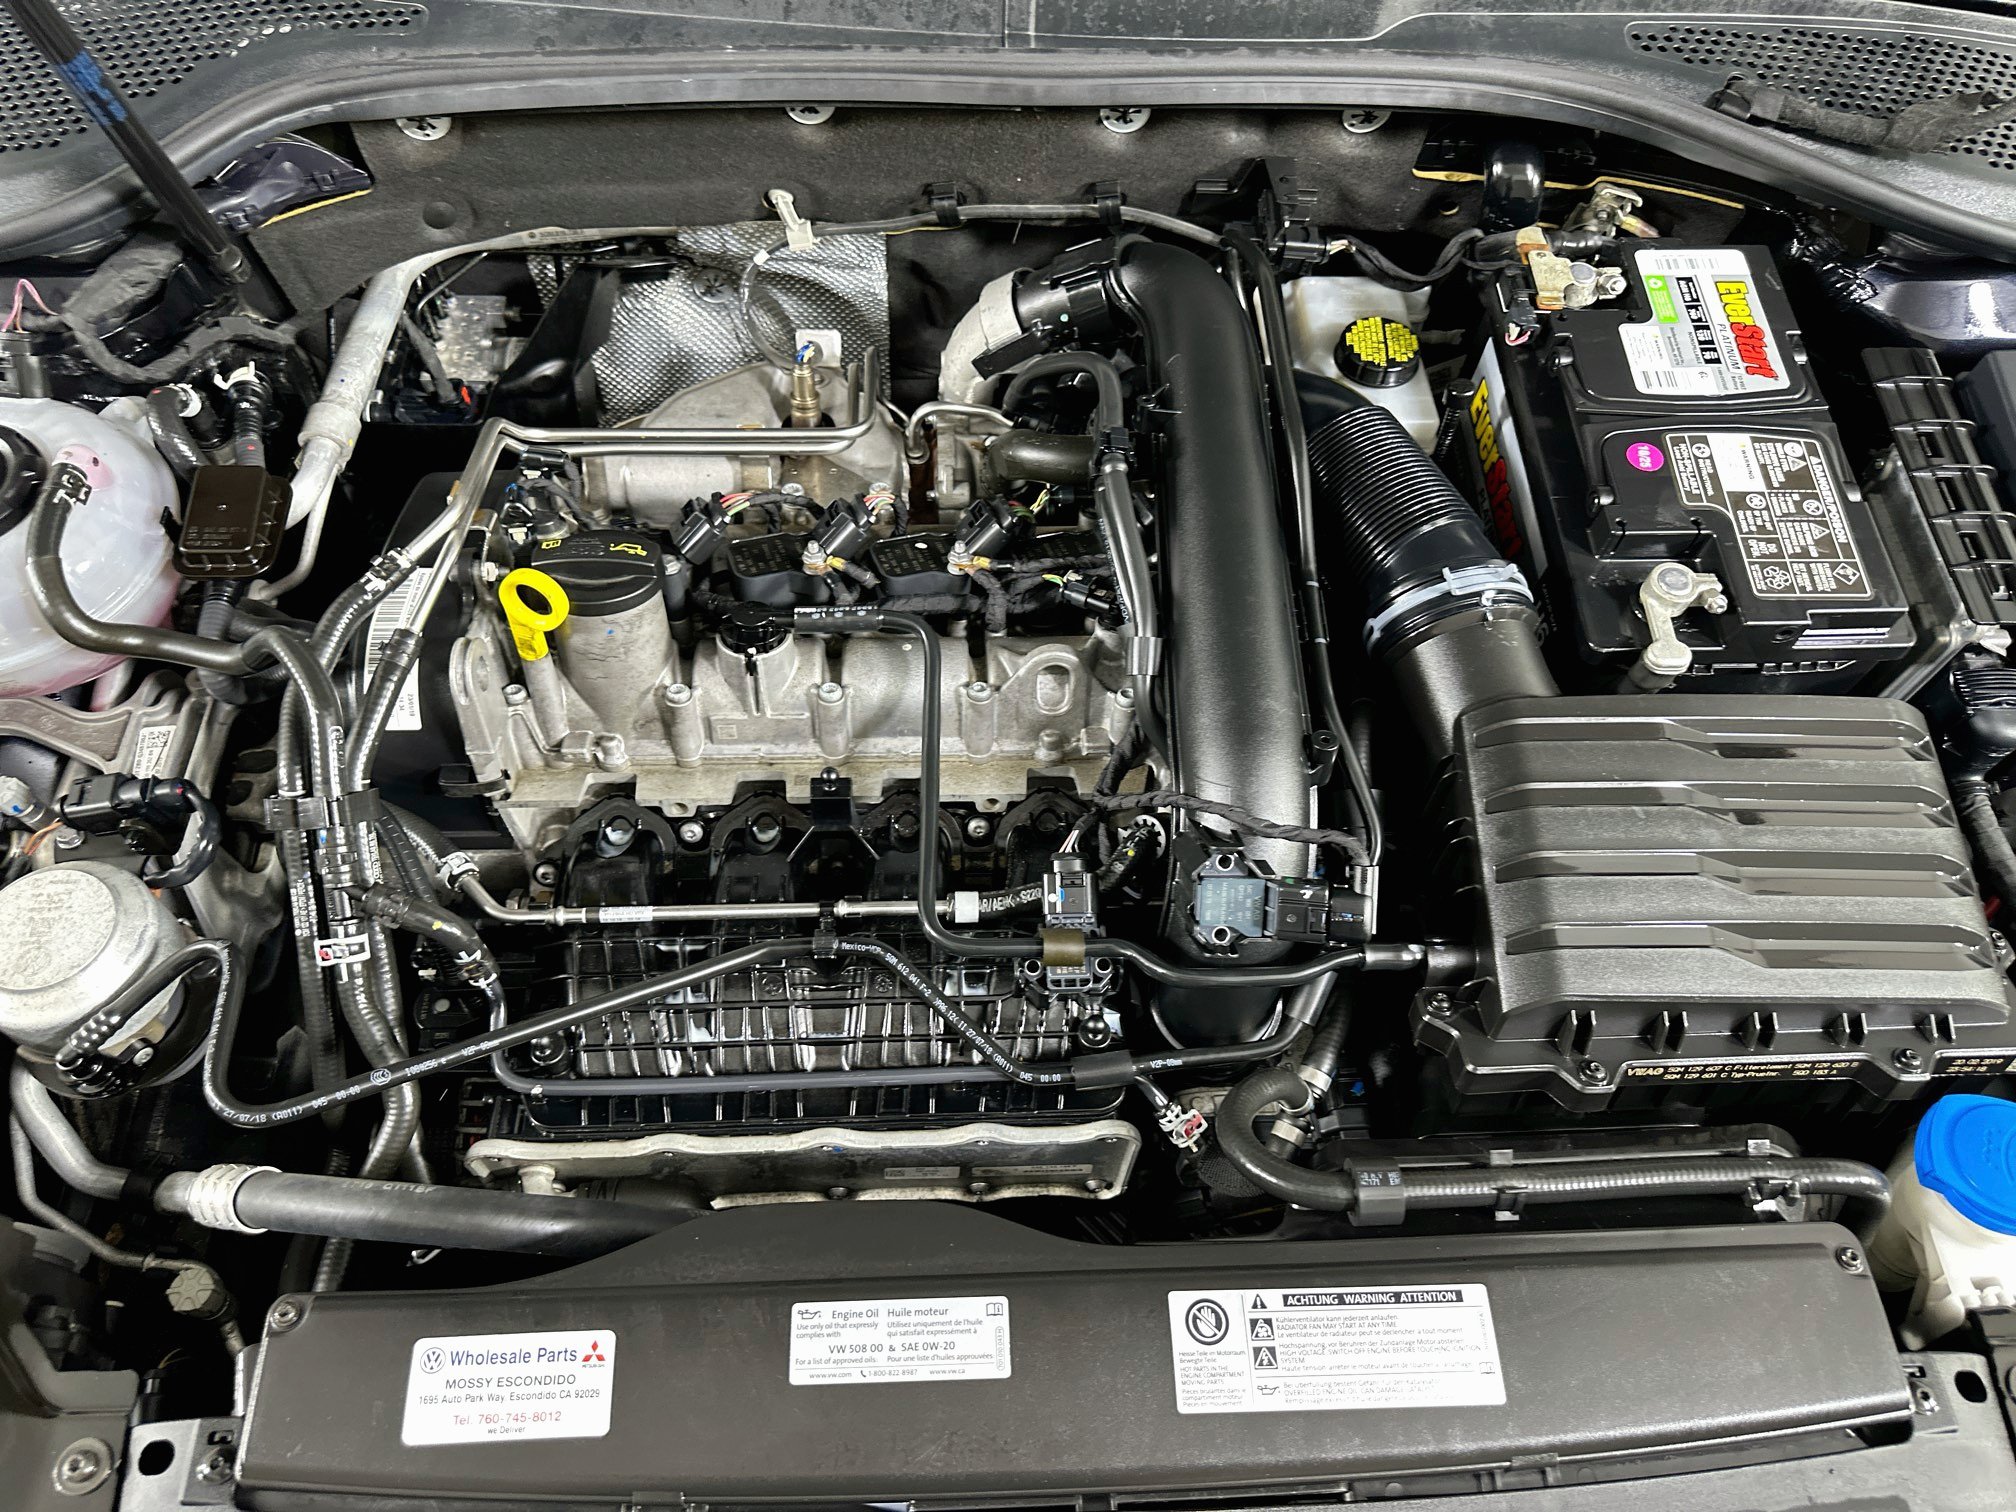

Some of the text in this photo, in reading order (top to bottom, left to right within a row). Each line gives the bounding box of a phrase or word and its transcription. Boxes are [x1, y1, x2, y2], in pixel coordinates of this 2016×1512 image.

[1715, 280, 1778, 380] EverStart
[1717, 323, 1741, 370] PLATINUM
[1741, 450, 1755, 480] WARNING
[1627, 1068, 1664, 1076] VWAG
[1733, 1063, 1792, 1071] Filterelement
[223, 1108, 267, 1123] 27/07/18
[1286, 1291, 1457, 1306] ACHTUNG WARNING ATTENTION
[831, 1309, 879, 1321] Engine Oil
[887, 1307, 949, 1318] Huile moteur
[810, 1322, 824, 1331] only
[825, 1321, 834, 1329] oil
[834, 1321, 847, 1329] that
[848, 1320, 878, 1330] expressly
[887, 1320, 911, 1329] Utilisez
[913, 1319, 952, 1329] uniquement
[954, 1318, 962, 1326] de
[796, 1330, 841, 1340] complies with
[887, 1329, 898, 1338] qui
[899, 1328, 924, 1337] satisfait
[926, 1327, 971, 1336] expressément
[829, 1341, 956, 1354] VW 508 00 & SAE 0W-20
[449, 1348, 531, 1366] Wholesale
[537, 1347, 577, 1363] Parts
[796, 1358, 806, 1366] For
[813, 1357, 822, 1365] list
[824, 1357, 831, 1365] of
[833, 1357, 861, 1366] approved
[887, 1355, 901, 1363] Pour
[902, 1355, 914, 1363] une
[915, 1353, 930, 1362] liste
[445, 1374, 576, 1389] MOSSY ESCONDIDO
[419, 1395, 439, 1406] 1695
[441, 1394, 462, 1404] Auto
[465, 1393, 484, 1403] Park
[510, 1391, 557, 1401] Escondido
[560, 1390, 572, 1400] CA
[574, 1388, 600, 1399] 92029
[478, 1411, 562, 1424] 760-745-8012
